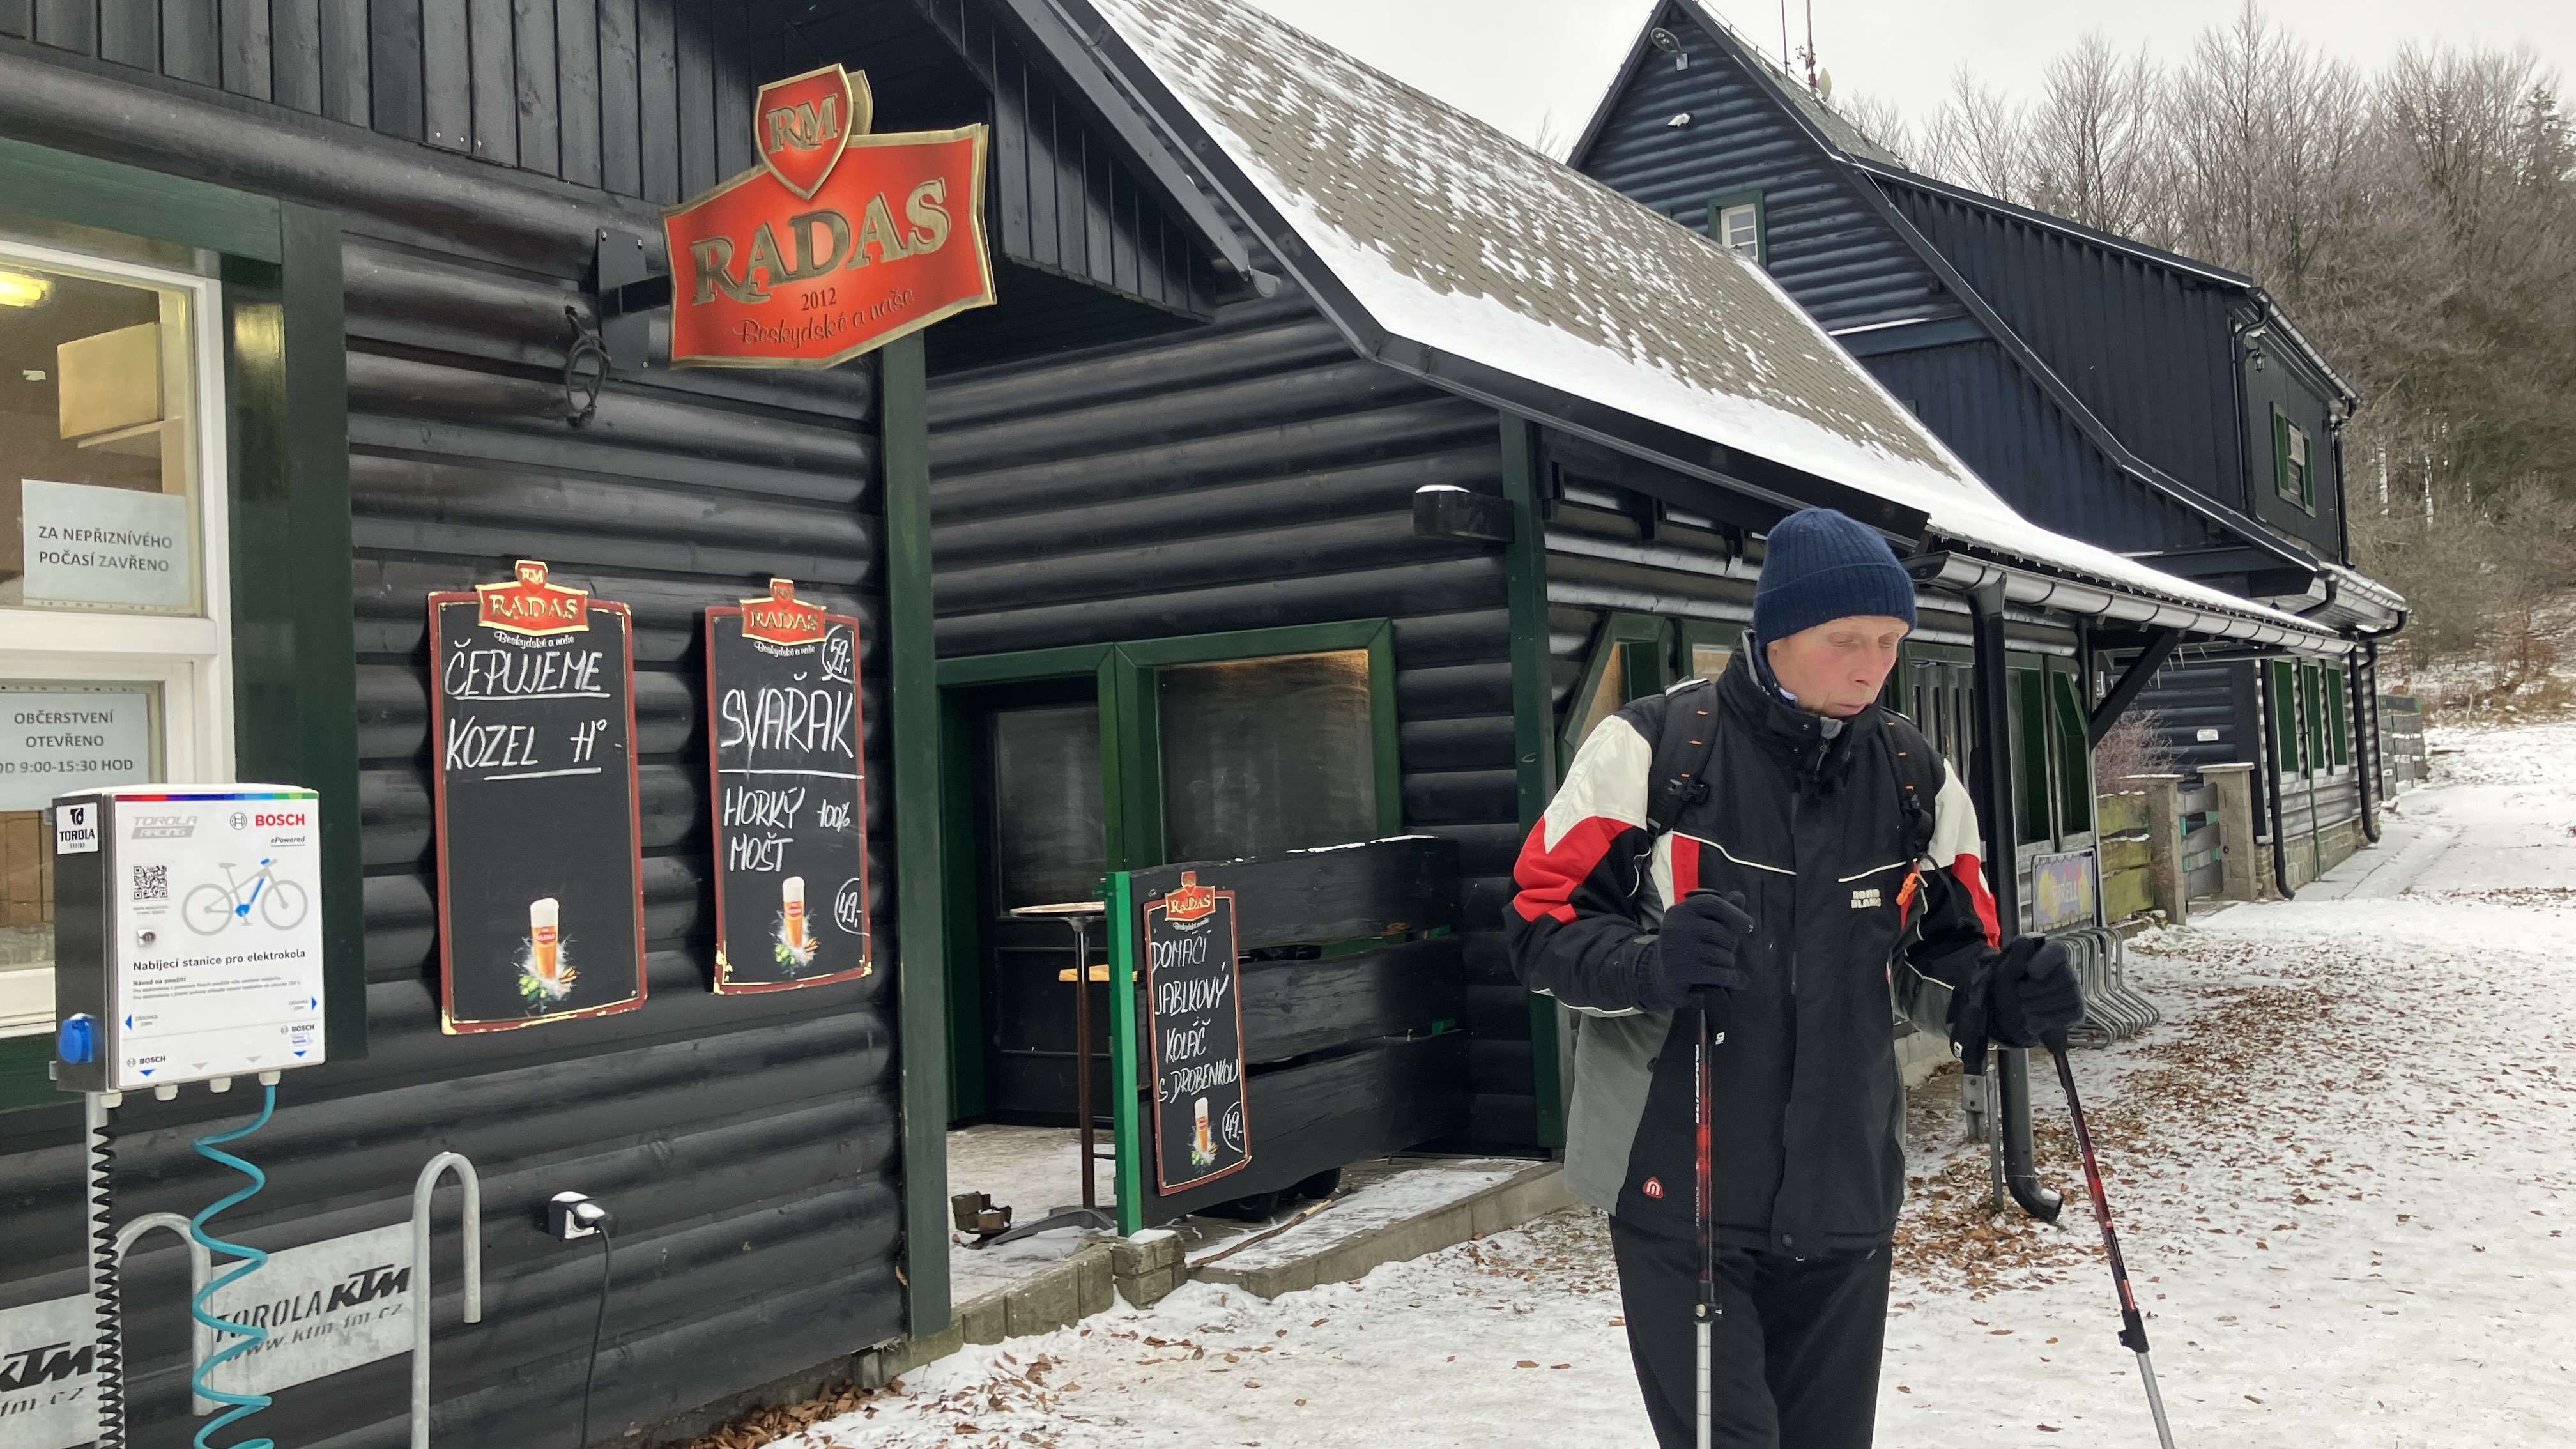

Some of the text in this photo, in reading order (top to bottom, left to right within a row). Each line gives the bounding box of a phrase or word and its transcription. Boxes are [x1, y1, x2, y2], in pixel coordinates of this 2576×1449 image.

[765, 93, 838, 154] RM
[689, 177, 951, 305] RADAS
[802, 288, 836, 312] 2012
[733, 286, 914, 350] Beskydské a naše
[39, 526, 172, 549] ZA NEPŘIZNÍVÉHO
[39, 549, 169, 572] POČASÍ ZAVŘENO
[520, 567, 544, 585] RM
[489, 594, 578, 620] RADAS
[750, 611, 819, 631] RADAS
[445, 638, 604, 696] ČEPUJEME
[14, 709, 114, 724] OBČERSTVENÍ
[26, 733, 104, 747] OTEVŘENO
[445, 716, 539, 770] KOZEL
[20, 760, 97, 773] 9:00-15:30
[102, 759, 133, 771] HOD
[724, 786, 805, 829] HORKÝ
[134, 815, 197, 826] TOROLA
[255, 813, 305, 827] BOSCH
[59, 829, 95, 842] TOROLA
[270, 836, 305, 844] ePowered
[729, 831, 794, 872] MOŠT
[1170, 894, 1211, 914] RADAS
[133, 949, 305, 971] Nabíjecí stanice pro elektrokola
[1154, 962, 1229, 1016] JABLKOVÝ
[291, 1023, 315, 1032] BOSCH
[1165, 1016, 1211, 1064] KOLÁČ
[139, 1055, 166, 1065] BOSCH
[1170, 1058, 1239, 1103] DROBENKOU
[216, 1264, 411, 1342] TOROLA KTM
